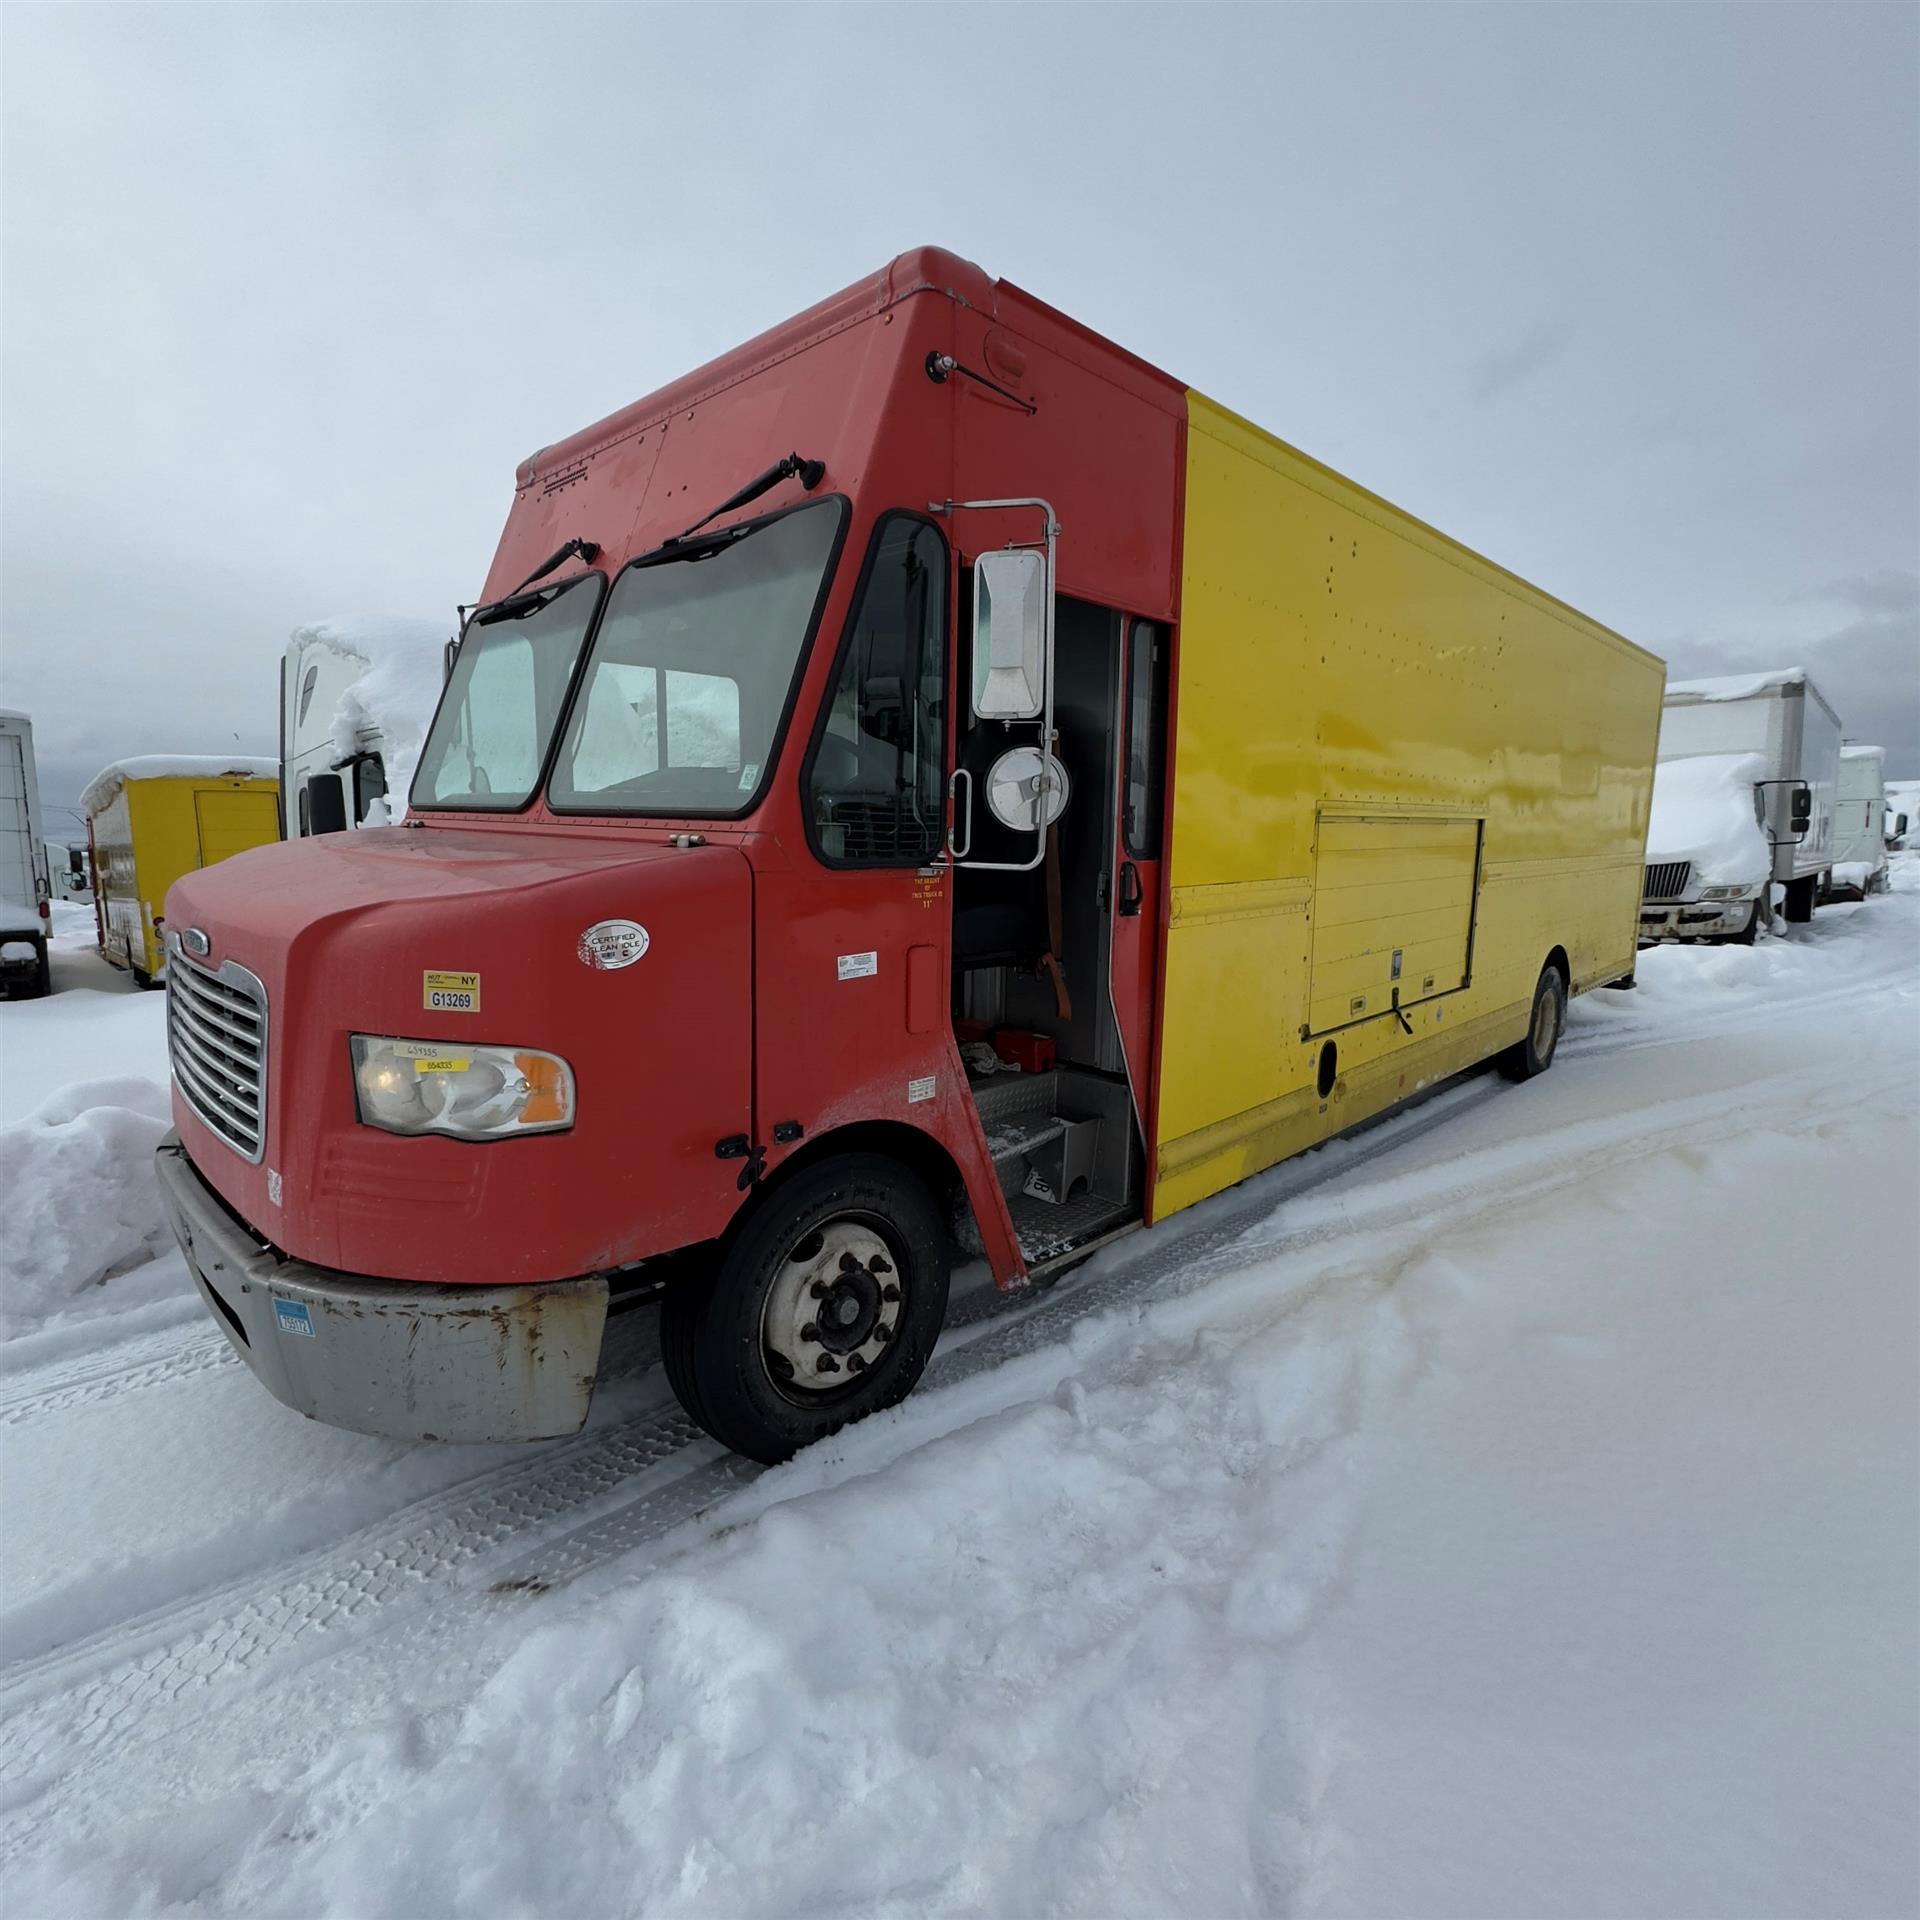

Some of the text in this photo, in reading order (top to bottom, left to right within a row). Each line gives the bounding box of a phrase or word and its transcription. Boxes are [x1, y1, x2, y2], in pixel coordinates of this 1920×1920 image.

[591, 933, 636, 945] CERTIFIED
[621, 940, 641, 949] IDLE
[461, 976, 477, 985] NY
[432, 992, 471, 1008] G13269
